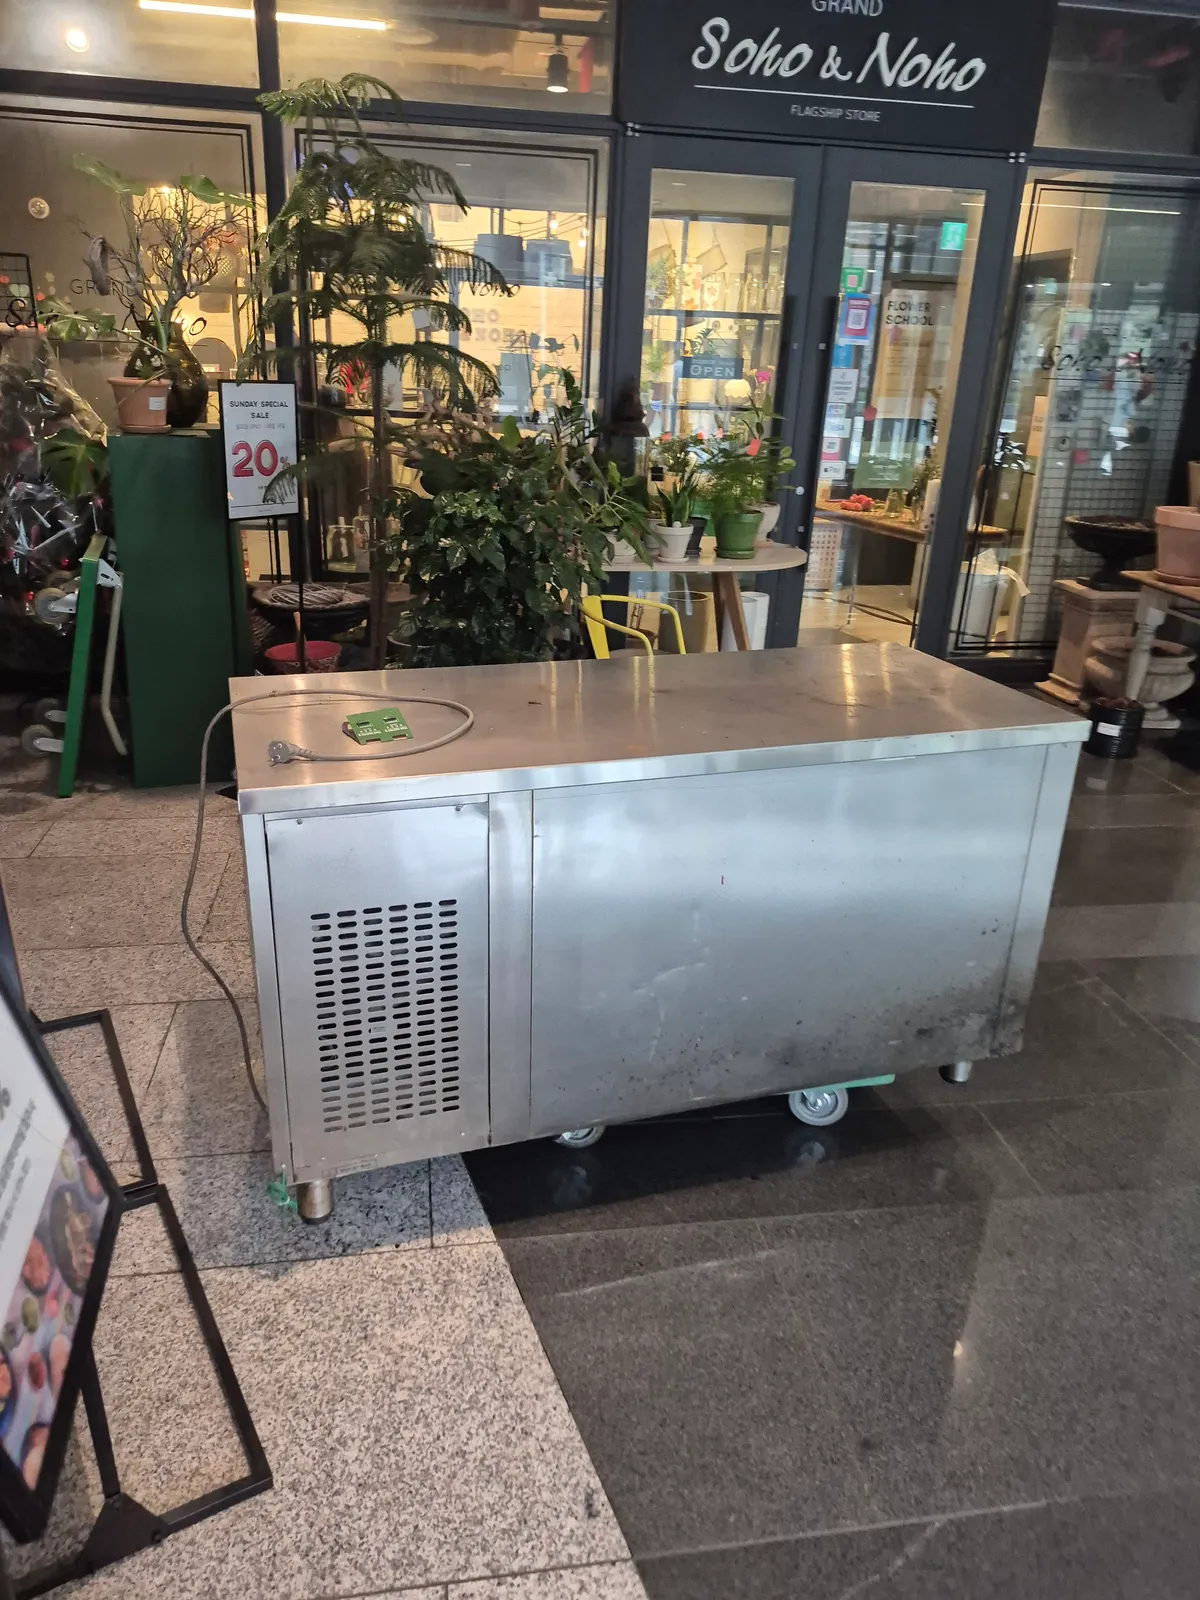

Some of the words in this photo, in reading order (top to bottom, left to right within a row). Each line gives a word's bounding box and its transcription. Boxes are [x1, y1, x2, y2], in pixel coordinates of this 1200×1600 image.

[811, 0, 884, 17] GRAND
[691, 16, 814, 77] Soho
[819, 45, 853, 81] &
[855, 31, 987, 92] Noho
[790, 104, 844, 119] FLAGSHIP
[844, 108, 881, 123] STORE
[70, 278, 138, 297] GRND
[885, 314, 933, 326] SCHOOL
[690, 365, 735, 377] OPEN
[229, 400, 258, 408] SUNDAY
[260, 400, 288, 408] SPECIAL
